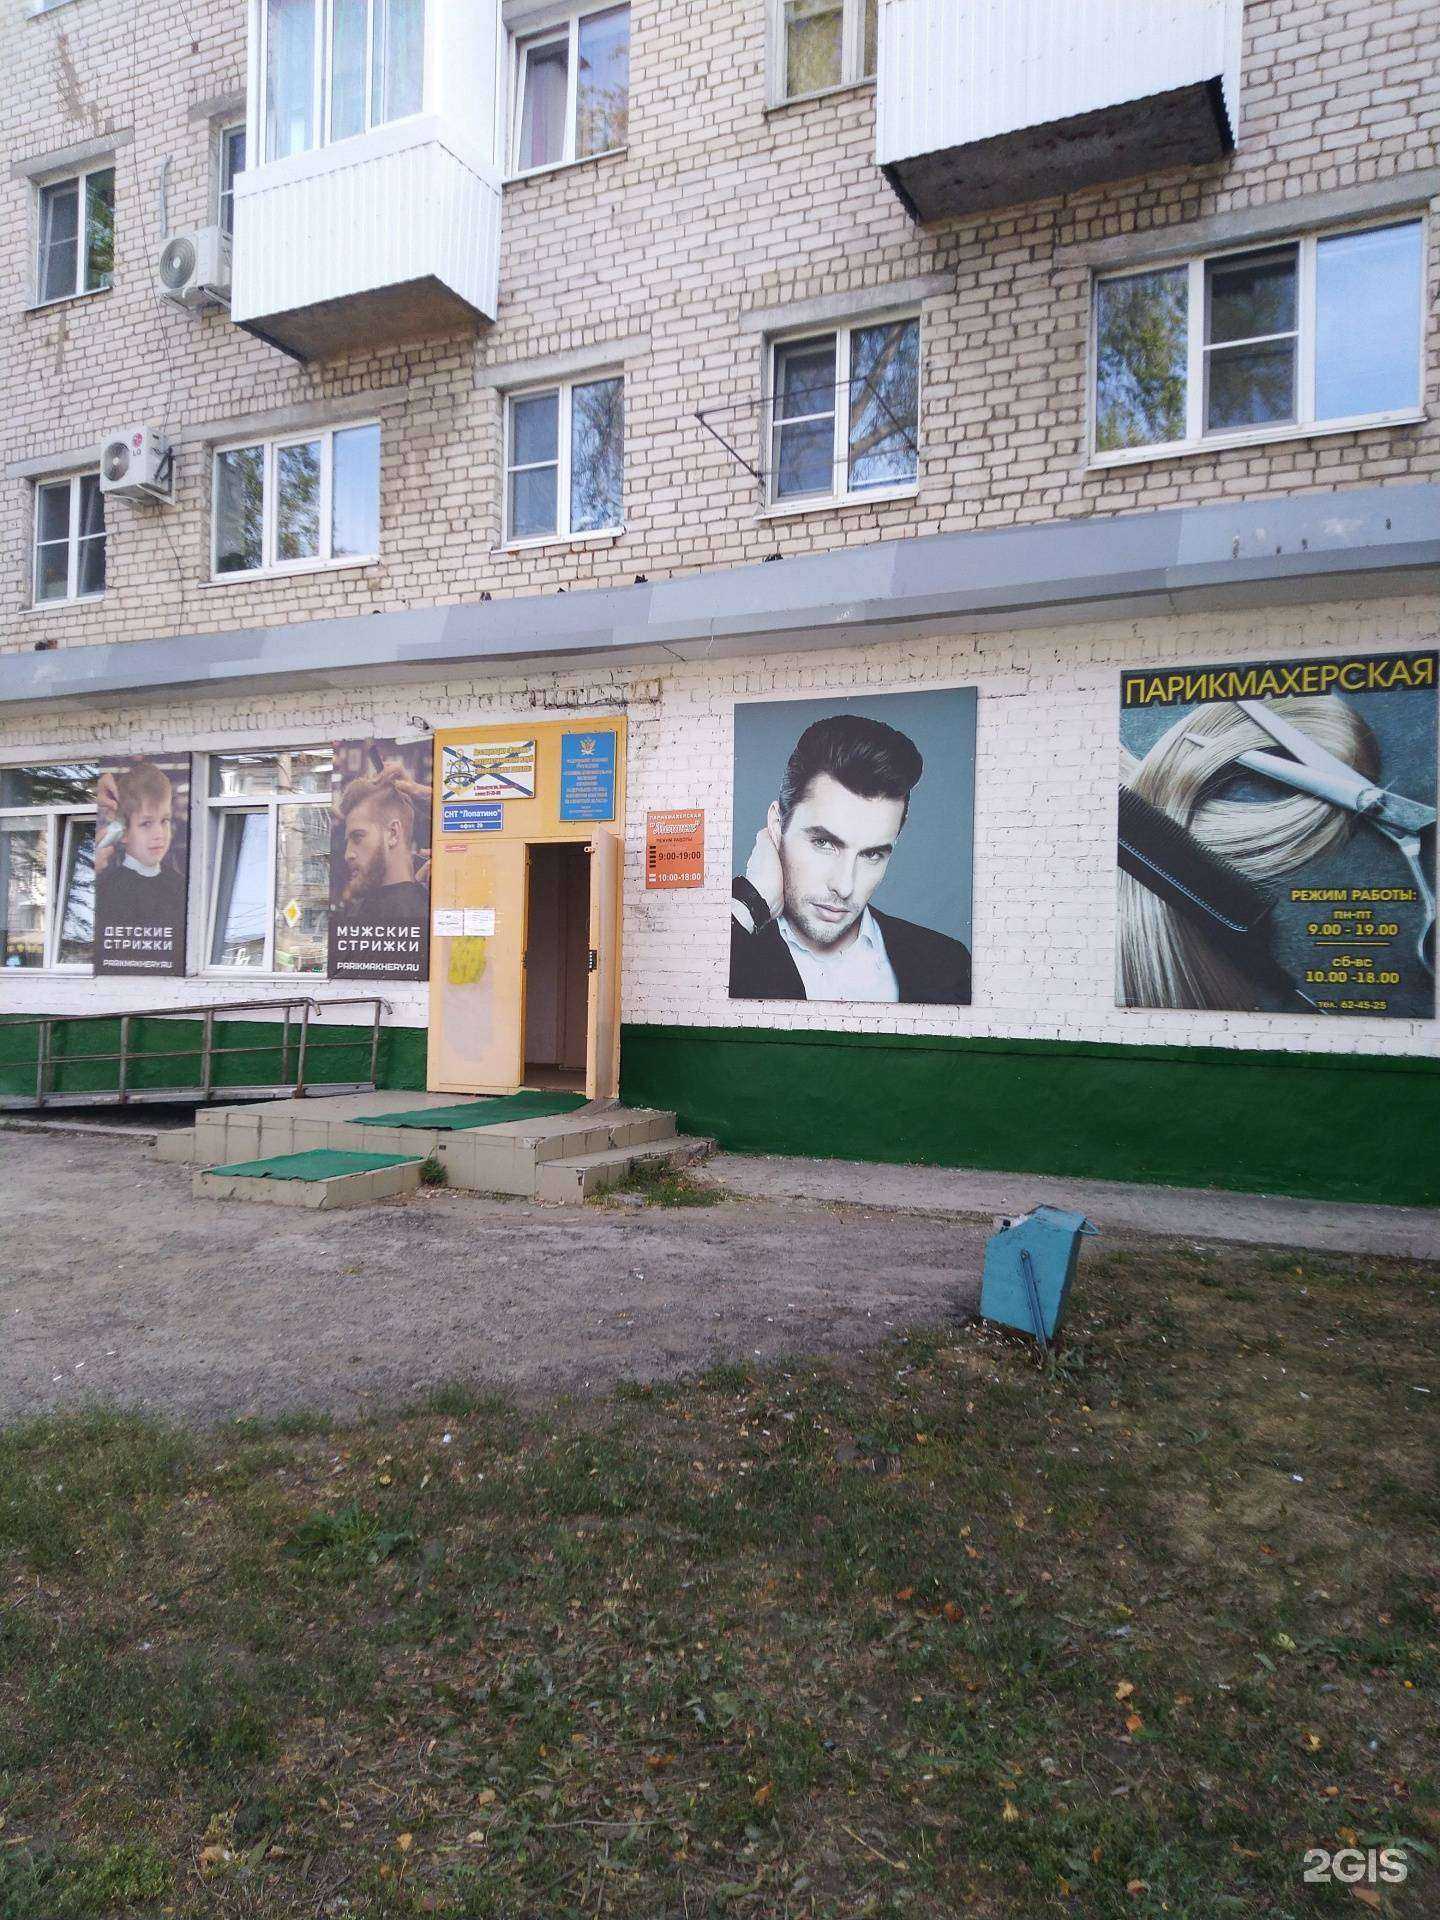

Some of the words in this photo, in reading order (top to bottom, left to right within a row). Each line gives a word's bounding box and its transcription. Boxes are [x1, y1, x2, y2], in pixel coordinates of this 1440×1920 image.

[1126, 658, 1434, 704] ПАРИКМАХЕРСКАЯ
[444, 810, 459, 818] СНТ
[658, 851, 701, 861] 9:00-19:00
[658, 872, 702, 882] 10:00-18:00
[1291, 889, 1347, 901] РЕЖИМ
[1352, 888, 1417, 901] РАБОТЫ:
[1333, 910, 1373, 920] пн-пт
[104, 926, 173, 938] ДЕТСКИЕ
[337, 926, 421, 938] МУЖСКИЕ
[1308, 923, 1342, 935] 9.00
[1355, 923, 1399, 936] 19.00
[103, 939, 173, 951] СТРИЖКИ
[337, 940, 420, 952] СТРИЖКИ
[336, 961, 420, 972] PARIKMAKHERY.RU
[1332, 956, 1374, 967] сб-вс
[1306, 971, 1348, 983] 10.00
